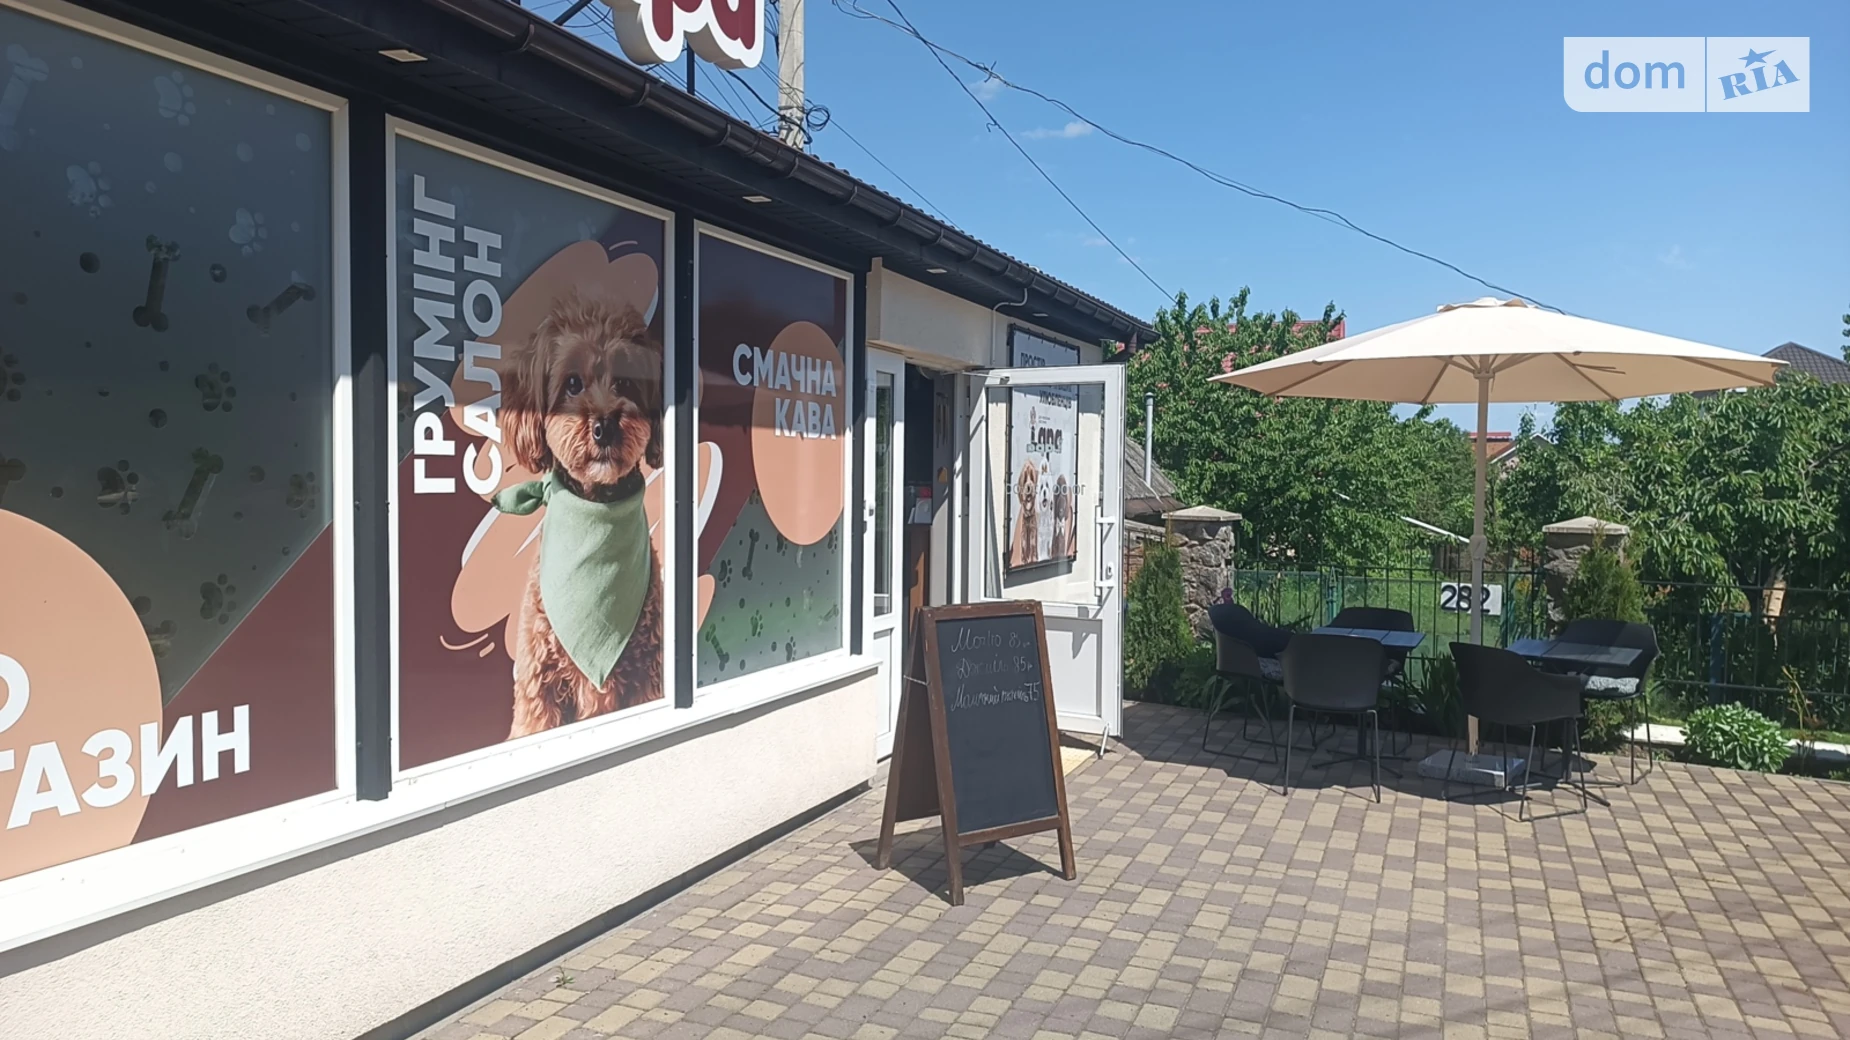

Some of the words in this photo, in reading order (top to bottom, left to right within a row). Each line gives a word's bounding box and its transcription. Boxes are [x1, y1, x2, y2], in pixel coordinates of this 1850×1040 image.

[413, 173, 456, 494] ГРУМІНГ
[463, 225, 502, 496] САЛОН
[733, 343, 837, 397] СМАЧНА
[775, 397, 837, 440] КАВА
